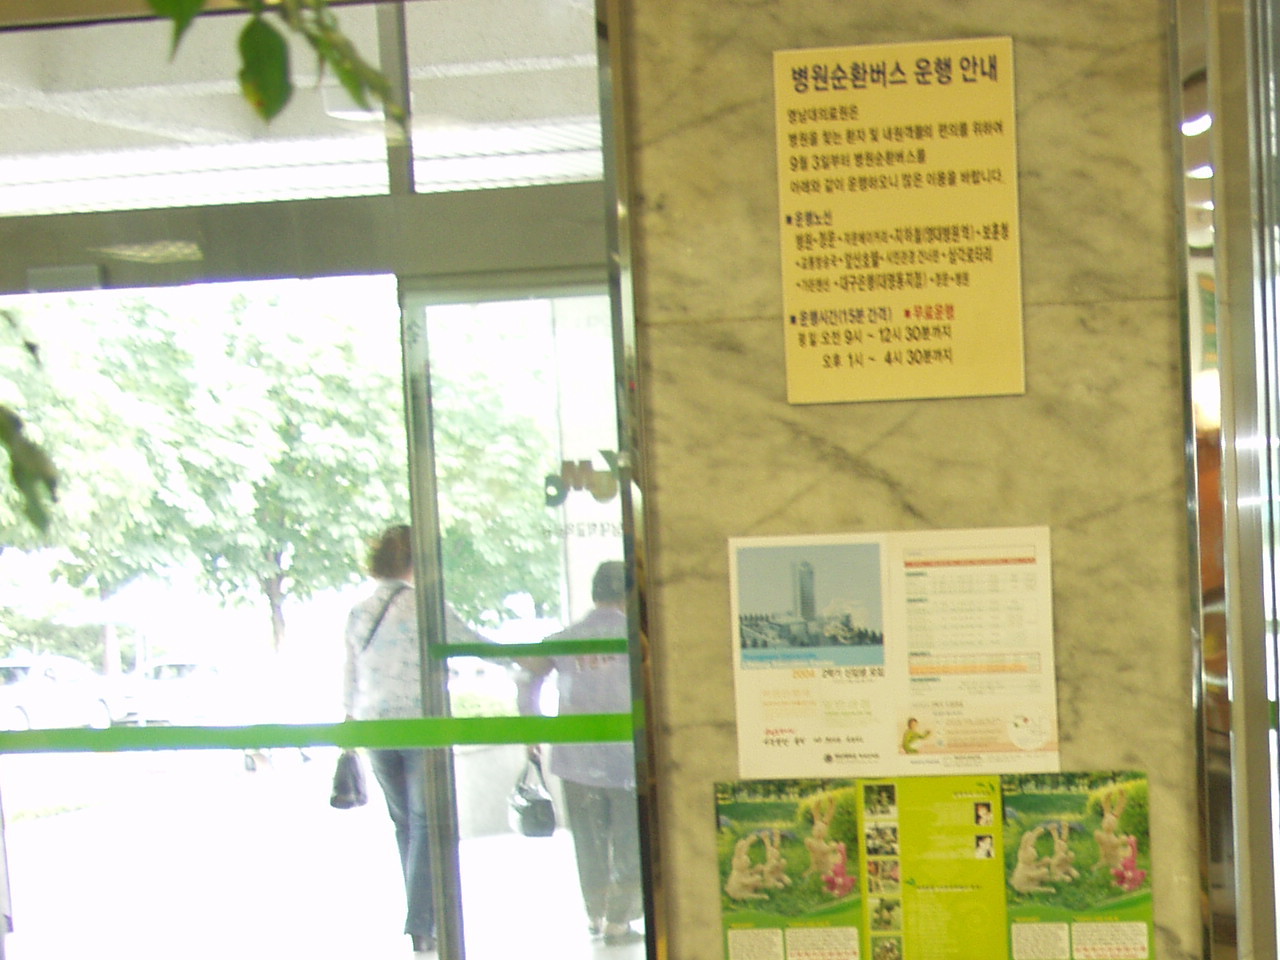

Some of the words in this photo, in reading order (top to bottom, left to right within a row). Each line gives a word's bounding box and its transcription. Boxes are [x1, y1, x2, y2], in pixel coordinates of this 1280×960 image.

[791, 60, 907, 93] 병원순환버스
[913, 56, 953, 85] 운행
[959, 54, 998, 83] 안내
[787, 104, 859, 125] 영남대의료원은
[853, 148, 926, 168] 병원순환버스를
[878, 325, 901, 344] 12시
[904, 323, 953, 342] 30분까지
[883, 349, 902, 367] 4시
[905, 346, 953, 365] 30분까지
